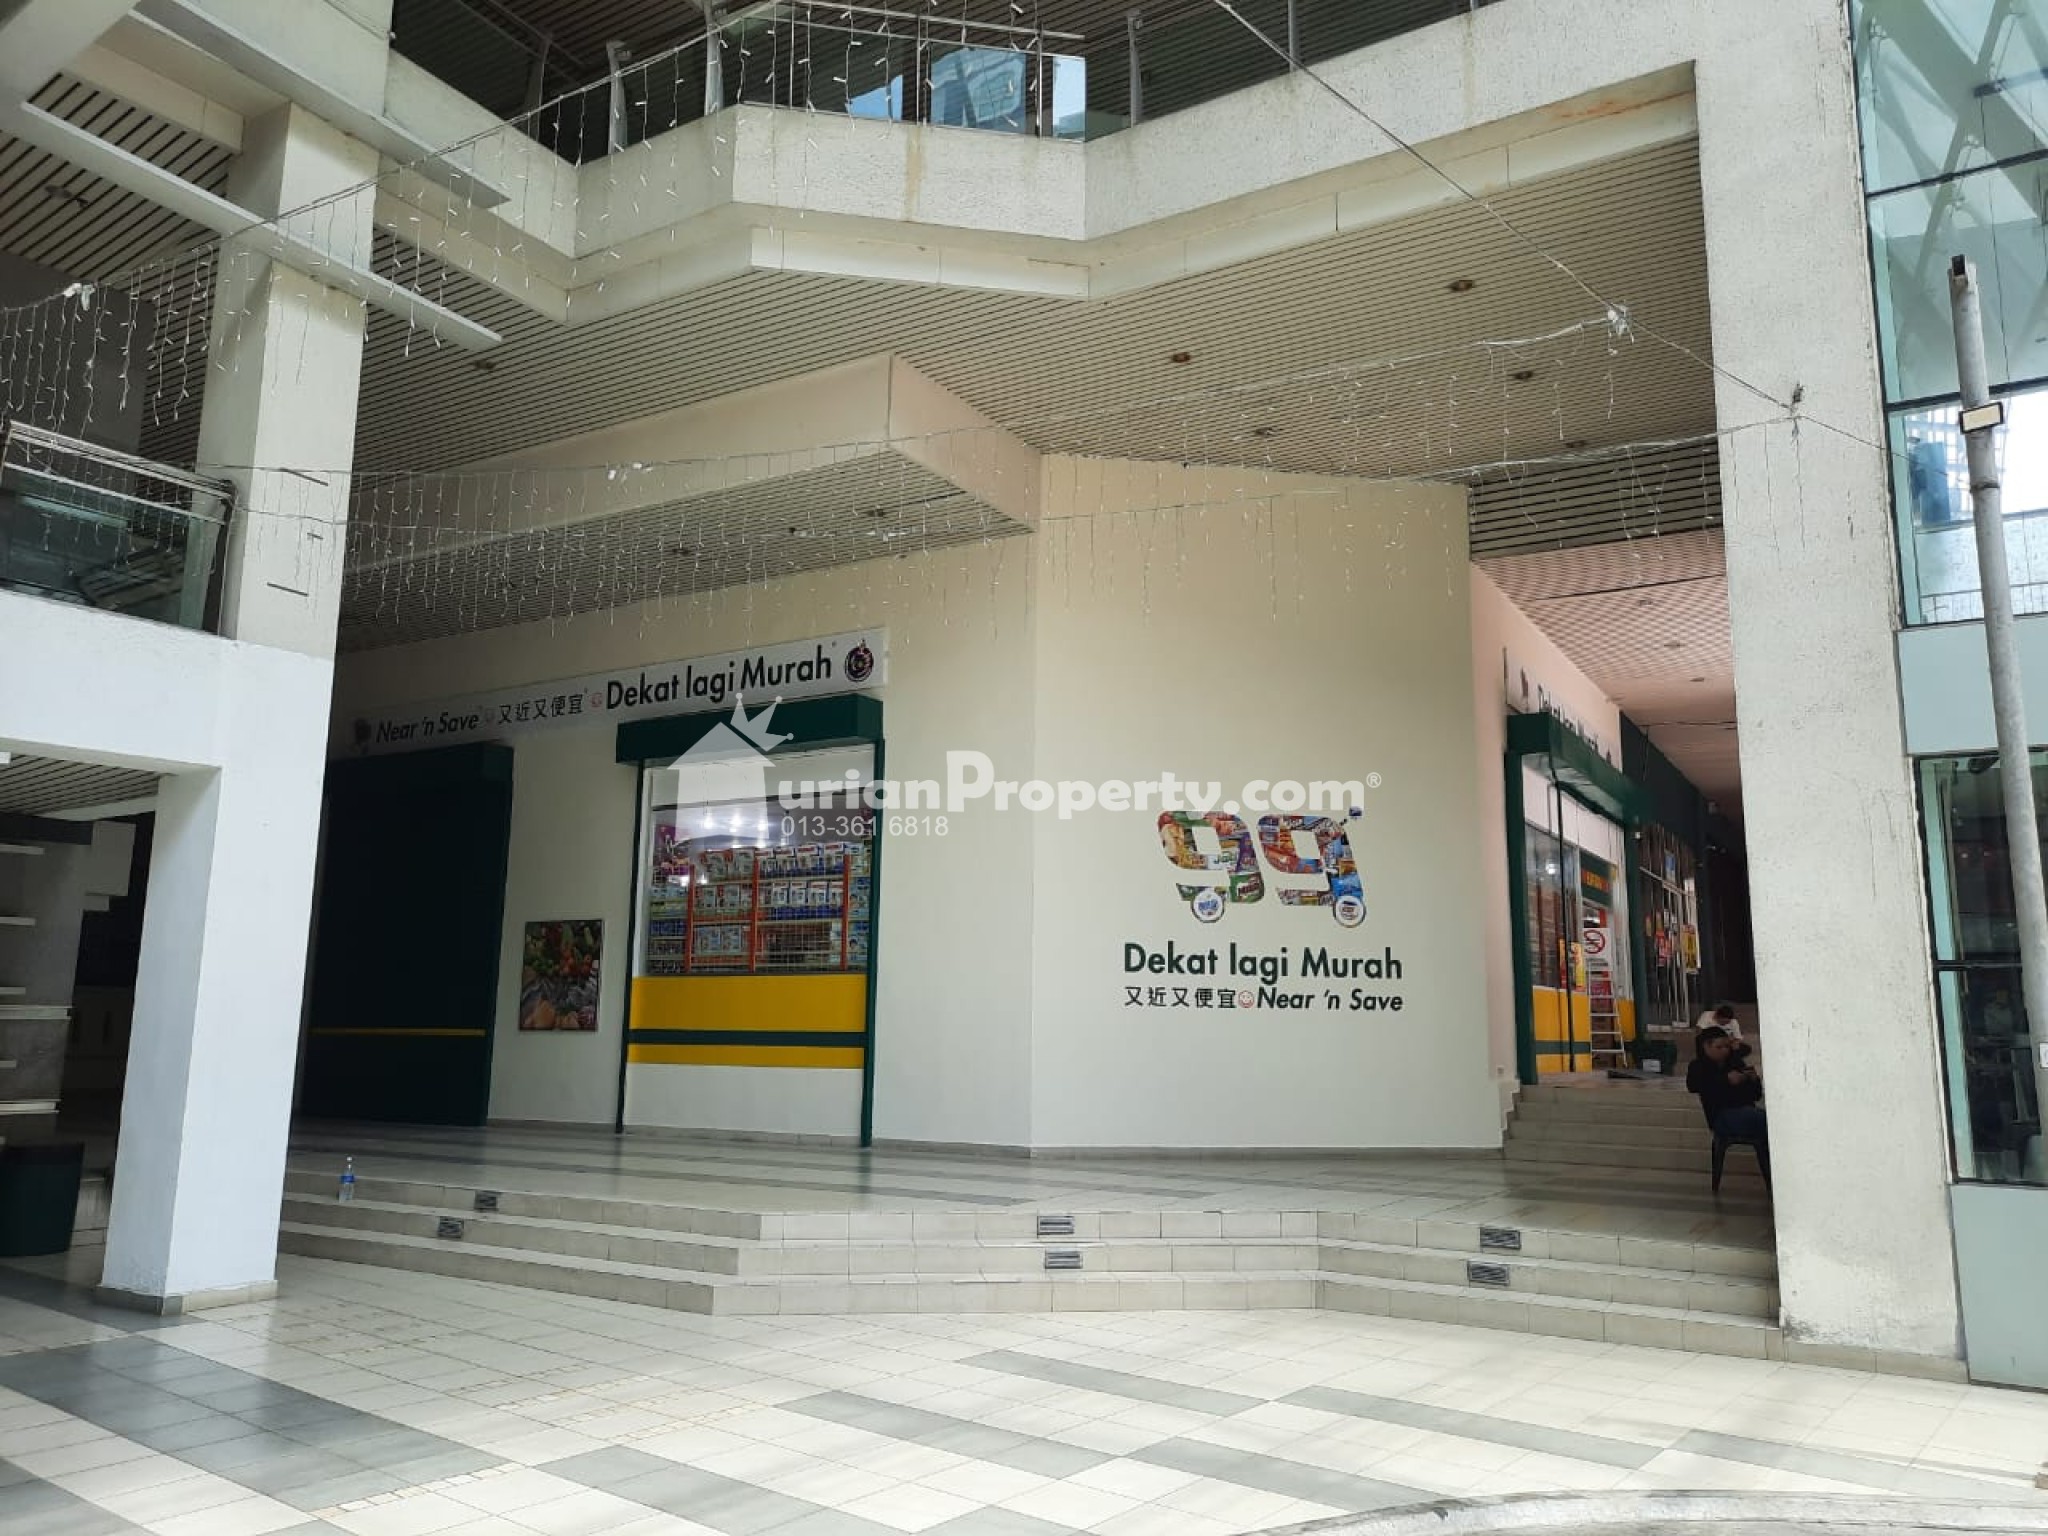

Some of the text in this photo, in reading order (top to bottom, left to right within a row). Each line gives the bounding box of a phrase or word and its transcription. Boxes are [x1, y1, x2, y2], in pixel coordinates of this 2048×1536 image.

[606, 644, 832, 710] Dekat lagi Murah
[498, 693, 583, 724] 又近又便宜
[376, 719, 418, 743] Near
[439, 711, 479, 734] Save
[1124, 940, 1403, 985] Dekat lagi Murah
[1124, 986, 1237, 1008] 又近又便宜
[1257, 987, 1315, 1009] Near
[1349, 988, 1403, 1011] Save
